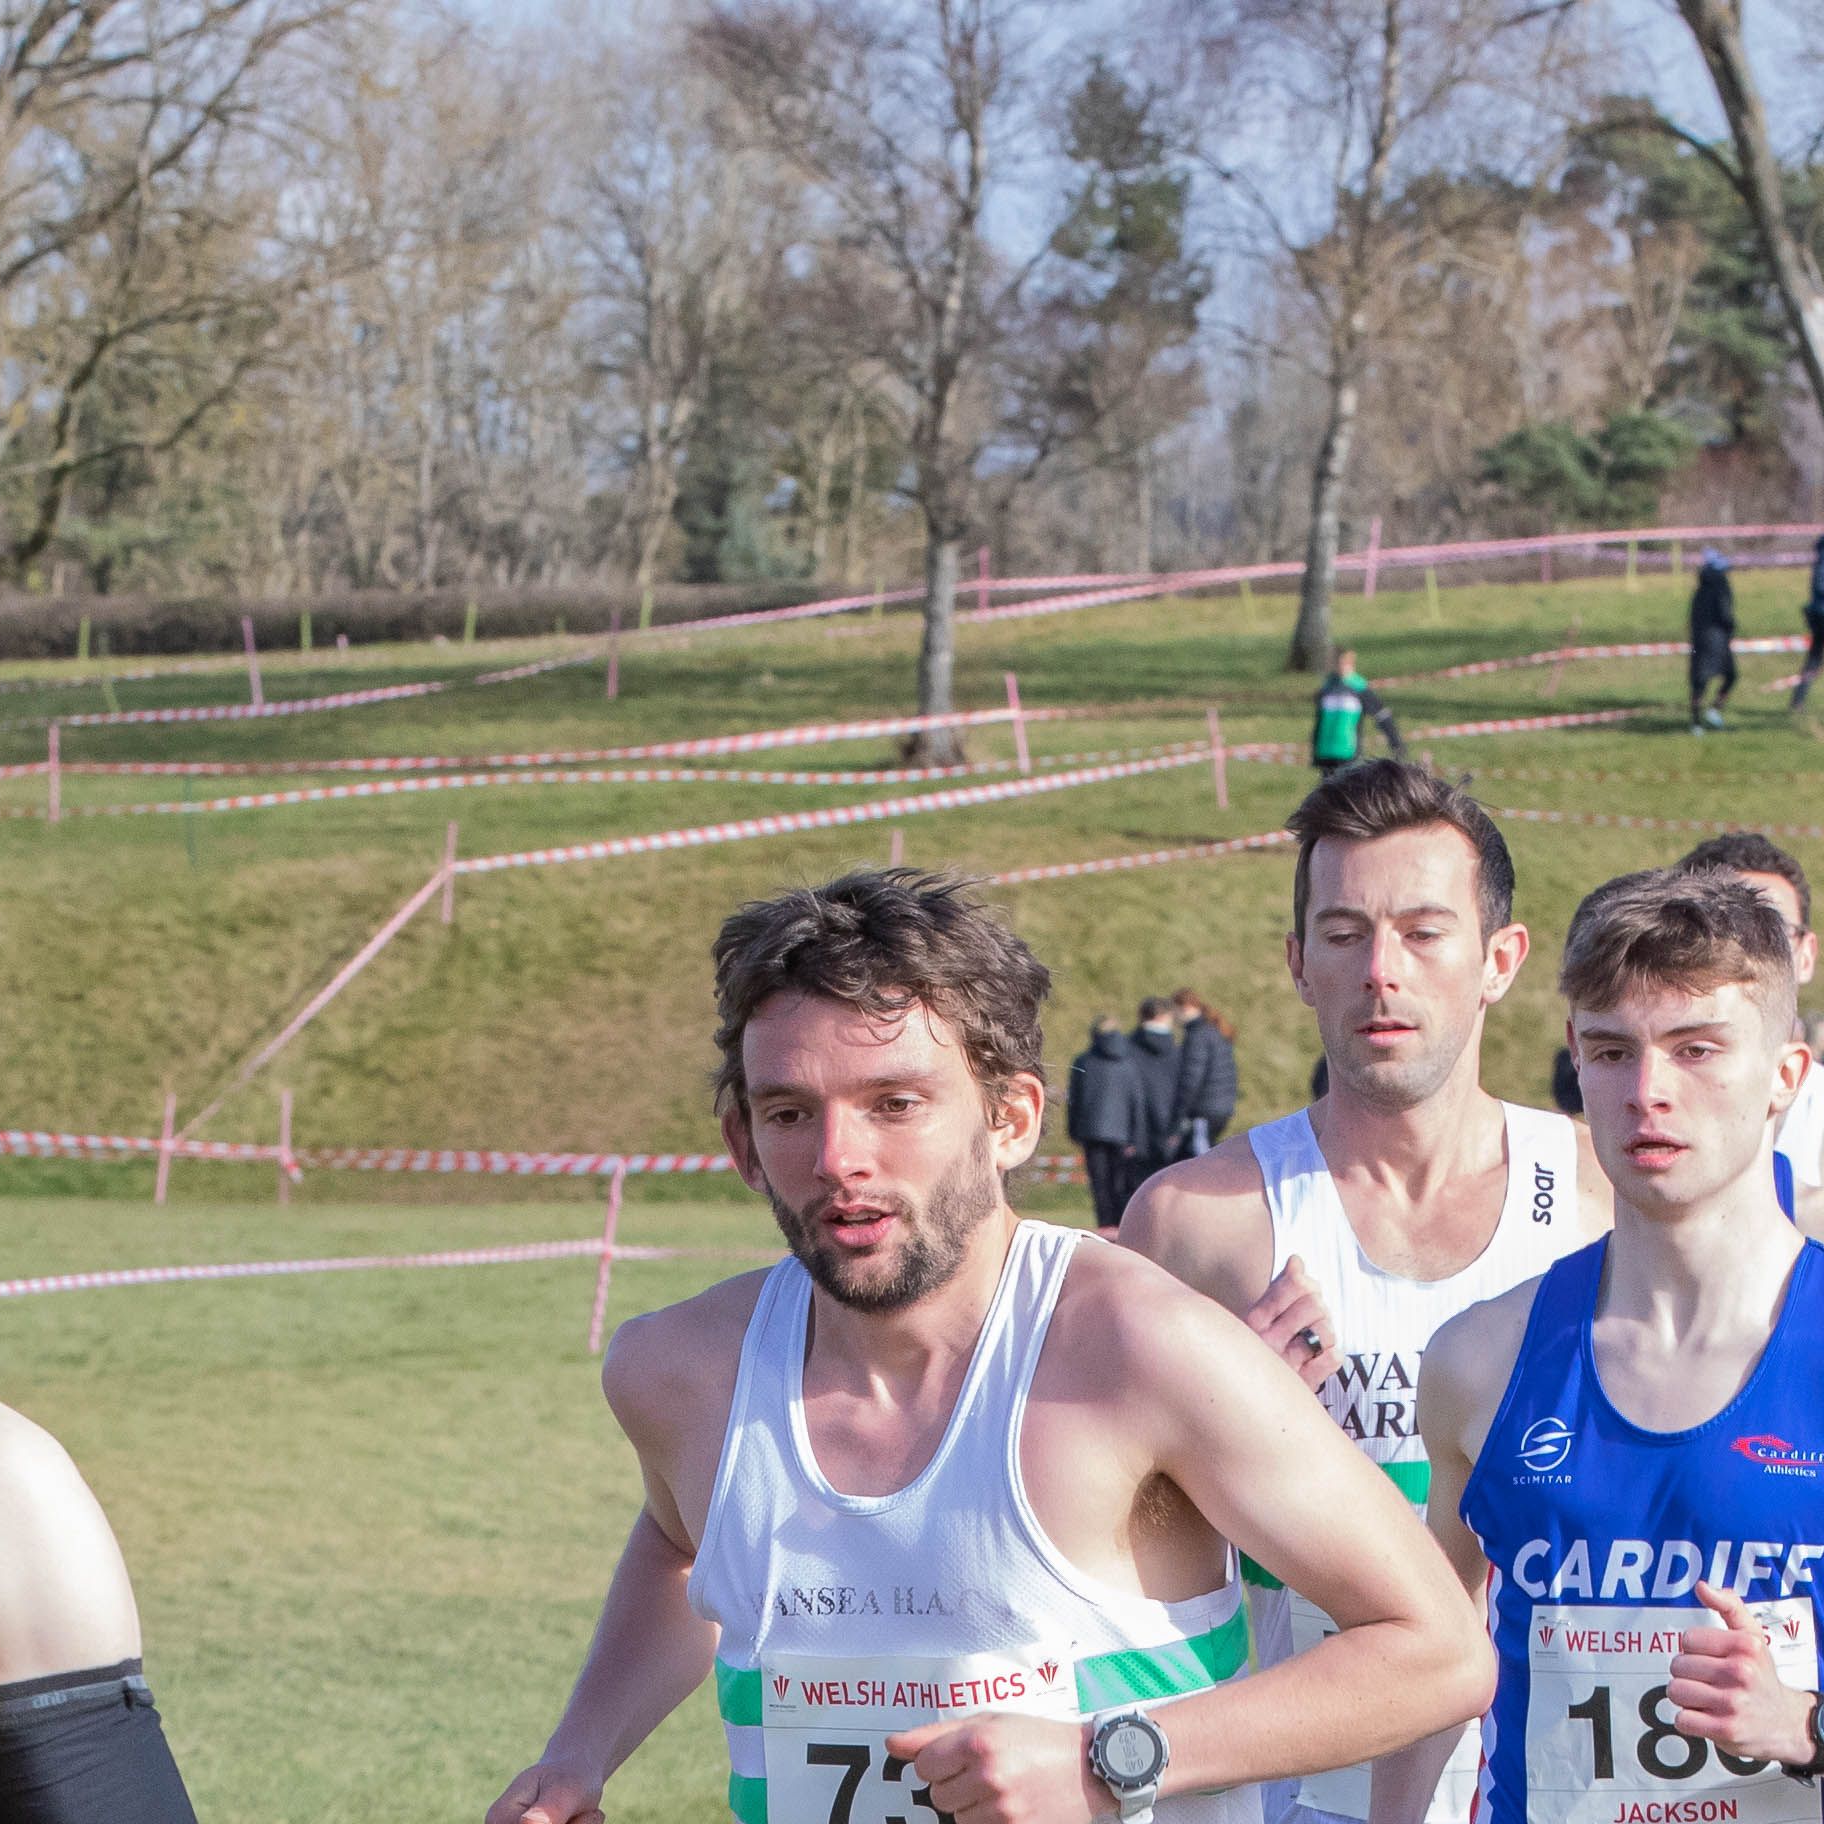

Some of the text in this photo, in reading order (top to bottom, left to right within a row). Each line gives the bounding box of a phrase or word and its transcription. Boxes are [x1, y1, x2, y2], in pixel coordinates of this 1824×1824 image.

[1532, 1162, 1554, 1226] soar
[1314, 1350, 1425, 1394] WA
[1757, 1447, 1824, 1463] Cardiff
[1513, 1474, 1573, 1485] SCIMITAR
[1763, 1464, 1817, 1478] Athletics
[1565, 1630, 1642, 1653] WELSH
[801, 1672, 1026, 1709] WELSH ATHLETICS
[1613, 1799, 1738, 1824] JACKSON
